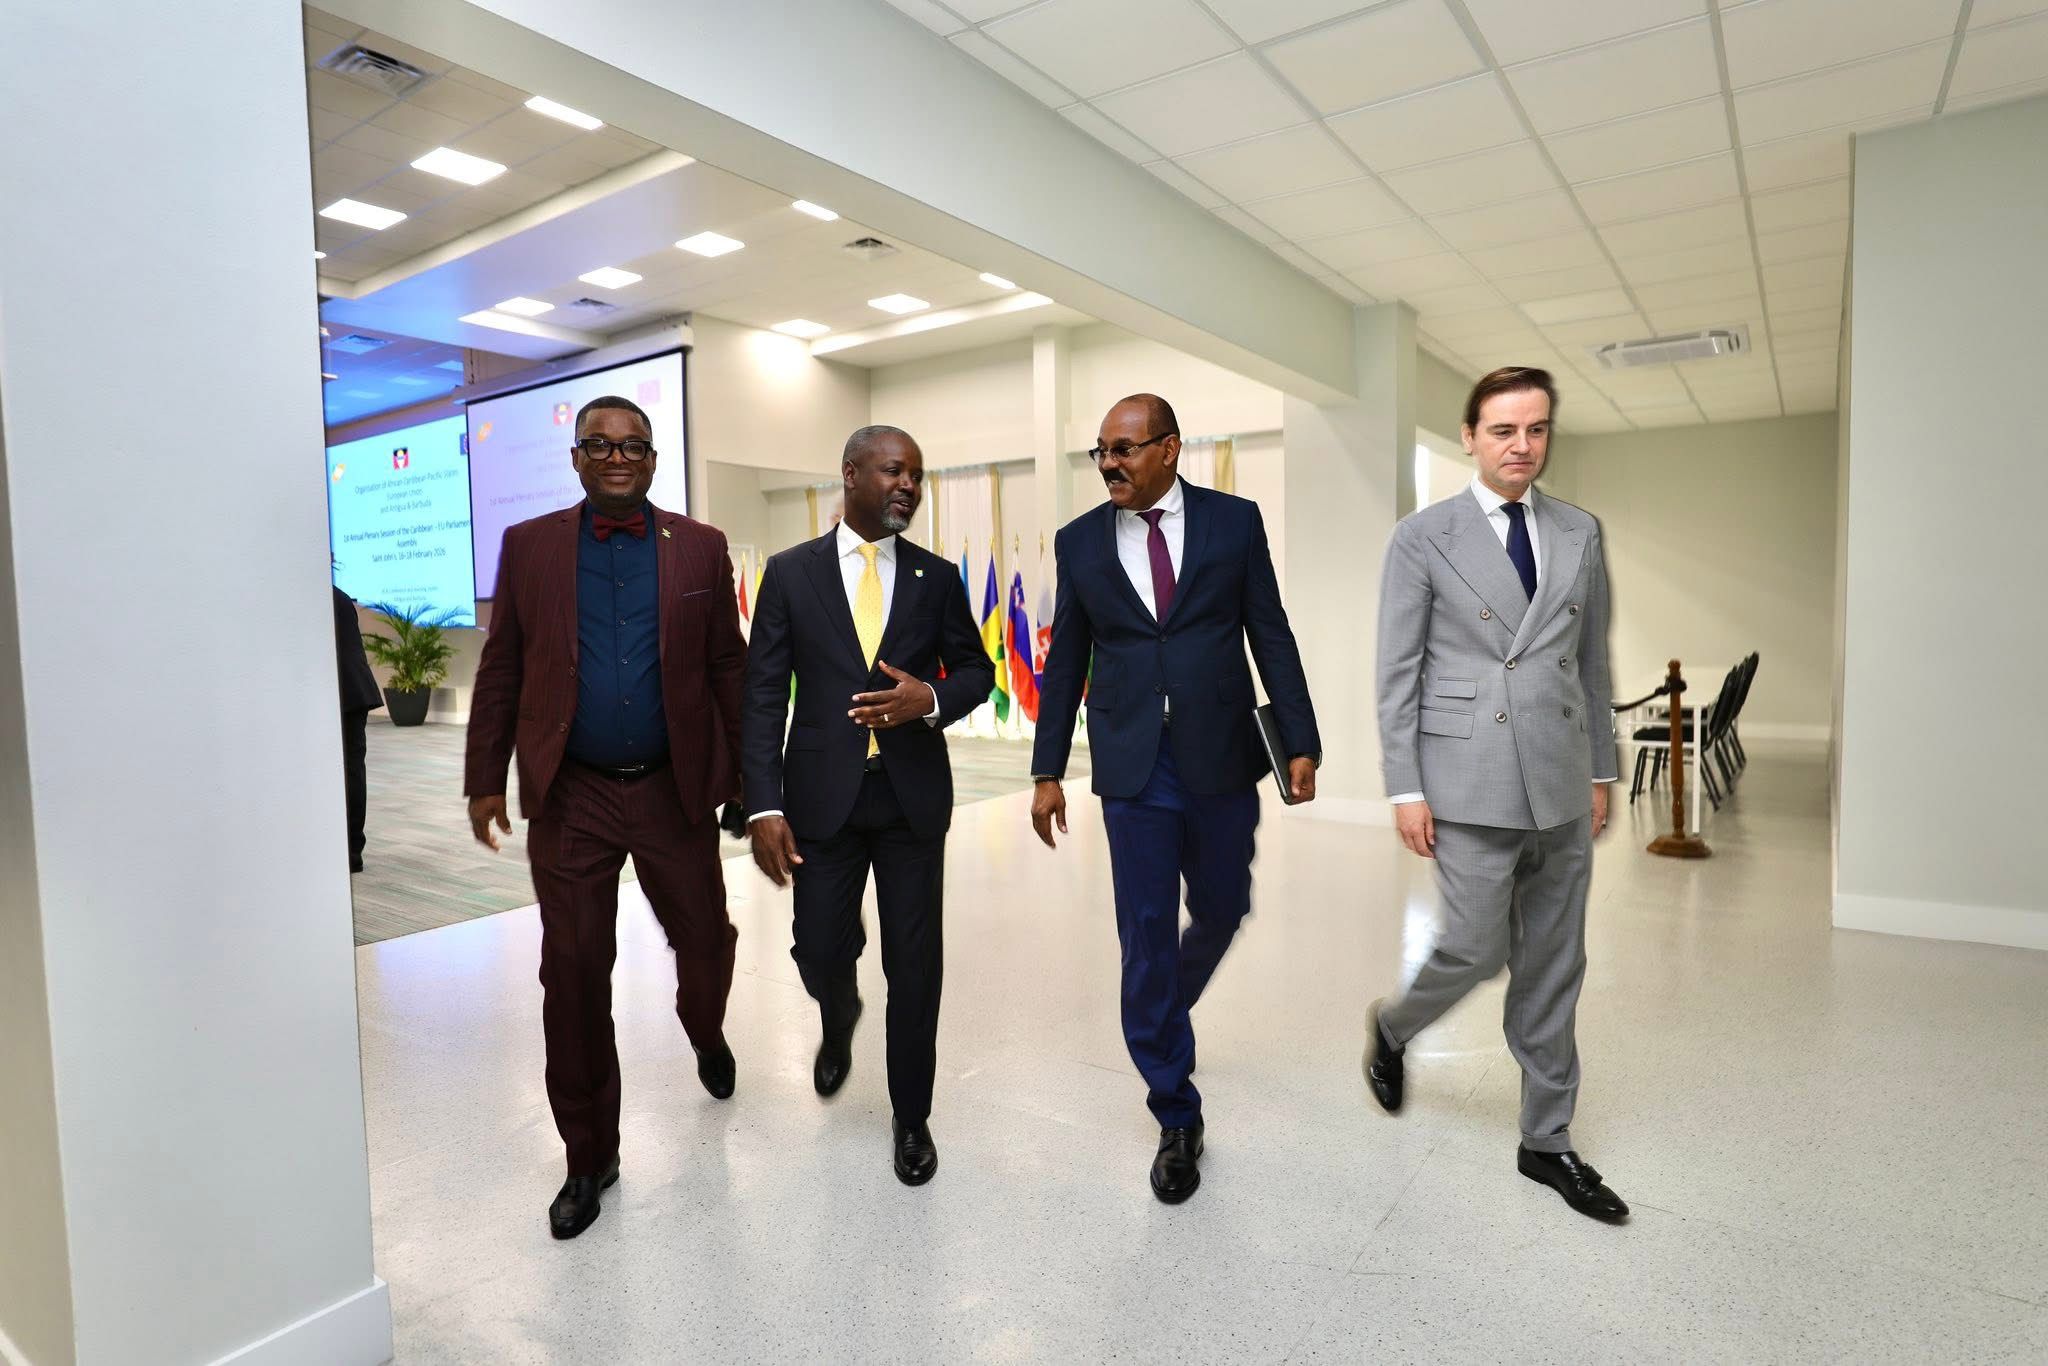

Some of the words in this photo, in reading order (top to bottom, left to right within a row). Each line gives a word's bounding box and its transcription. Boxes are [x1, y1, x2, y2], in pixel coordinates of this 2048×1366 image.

[389, 503, 406, 512] Antigua
[412, 499, 432, 508] Barbuda
[350, 532, 364, 542] Annual
[364, 531, 380, 540] Plenary
[380, 529, 395, 538] Session
[401, 527, 409, 535] the
[410, 524, 433, 534] Caribbean
[397, 537, 417, 548] Assembly
[412, 549, 433, 560] February
